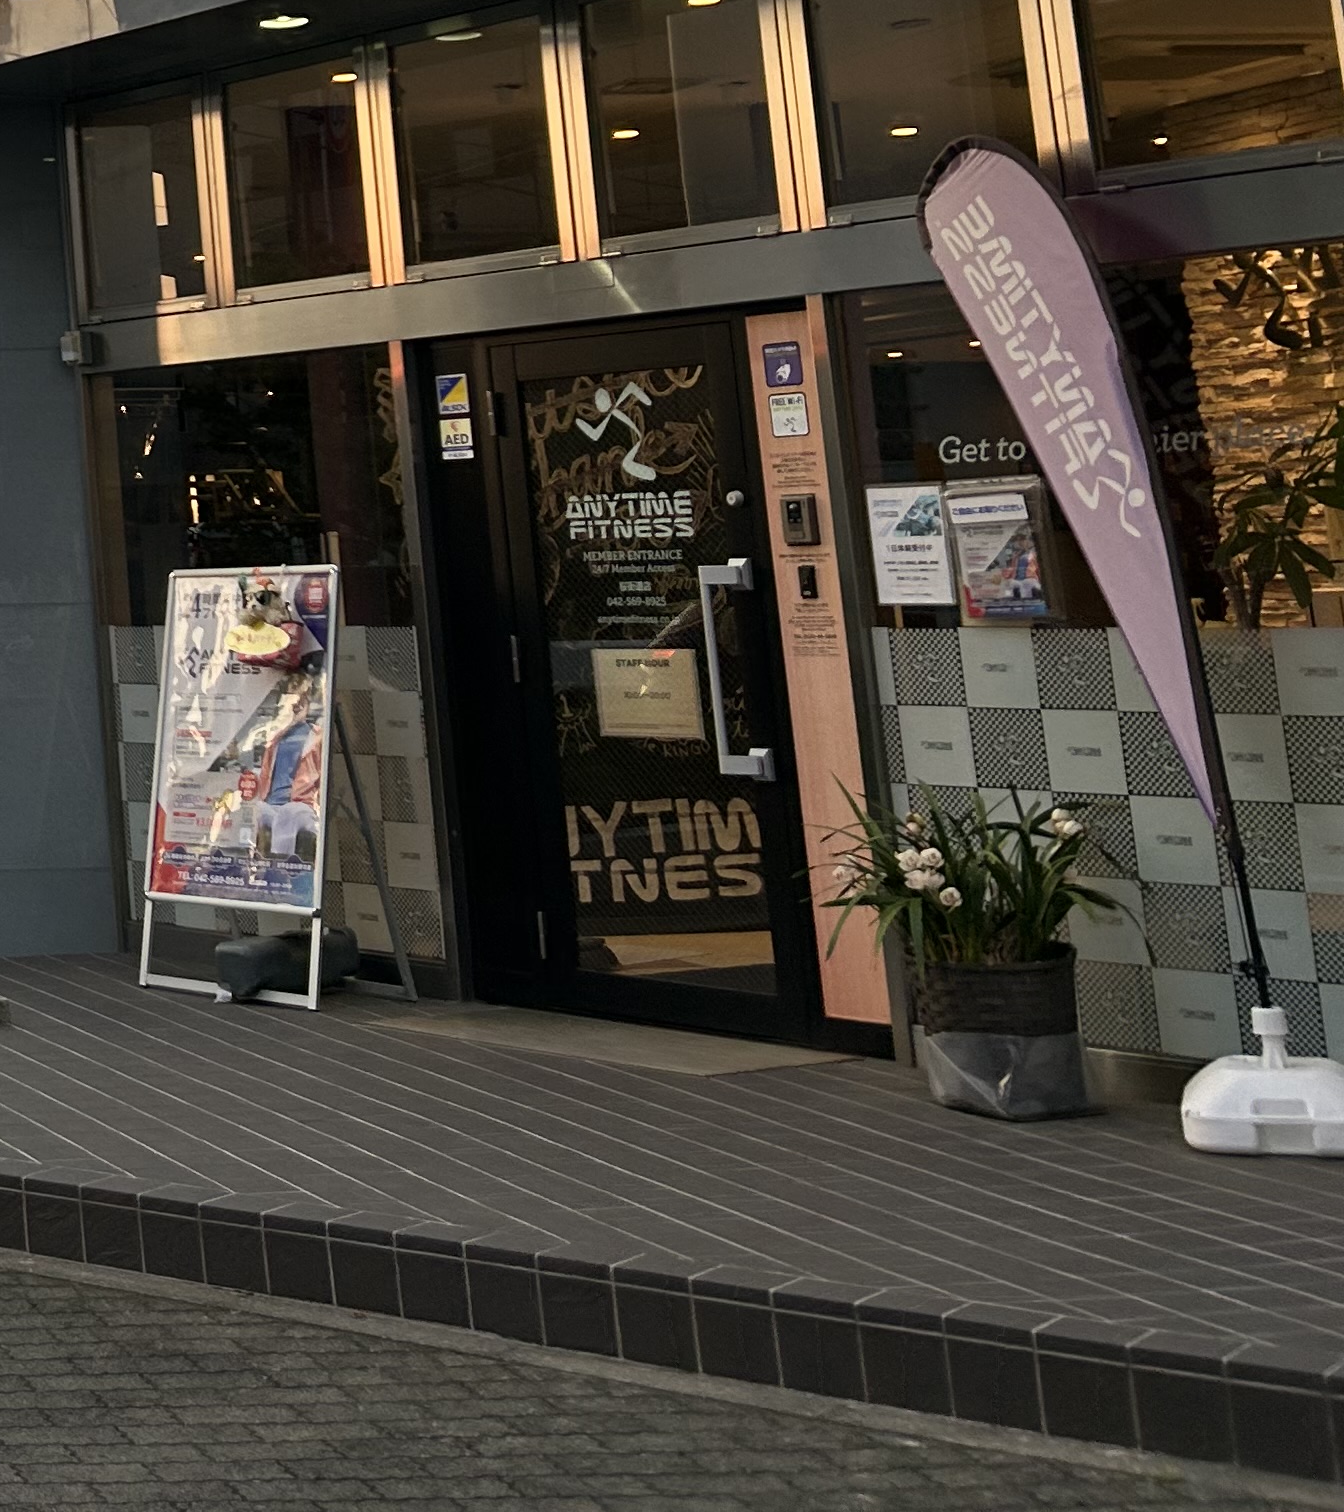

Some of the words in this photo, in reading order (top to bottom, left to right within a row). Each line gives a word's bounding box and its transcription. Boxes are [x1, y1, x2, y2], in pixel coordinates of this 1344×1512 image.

[445, 433, 469, 445] AED
[938, 436, 990, 464] Get
[996, 437, 1026, 461] to
[565, 490, 694, 519] ANYTIME
[569, 516, 695, 540] FITNESS
[583, 550, 627, 562] MEMBER
[627, 549, 683, 561] ENTRANCE
[615, 658, 642, 668] STAFF
